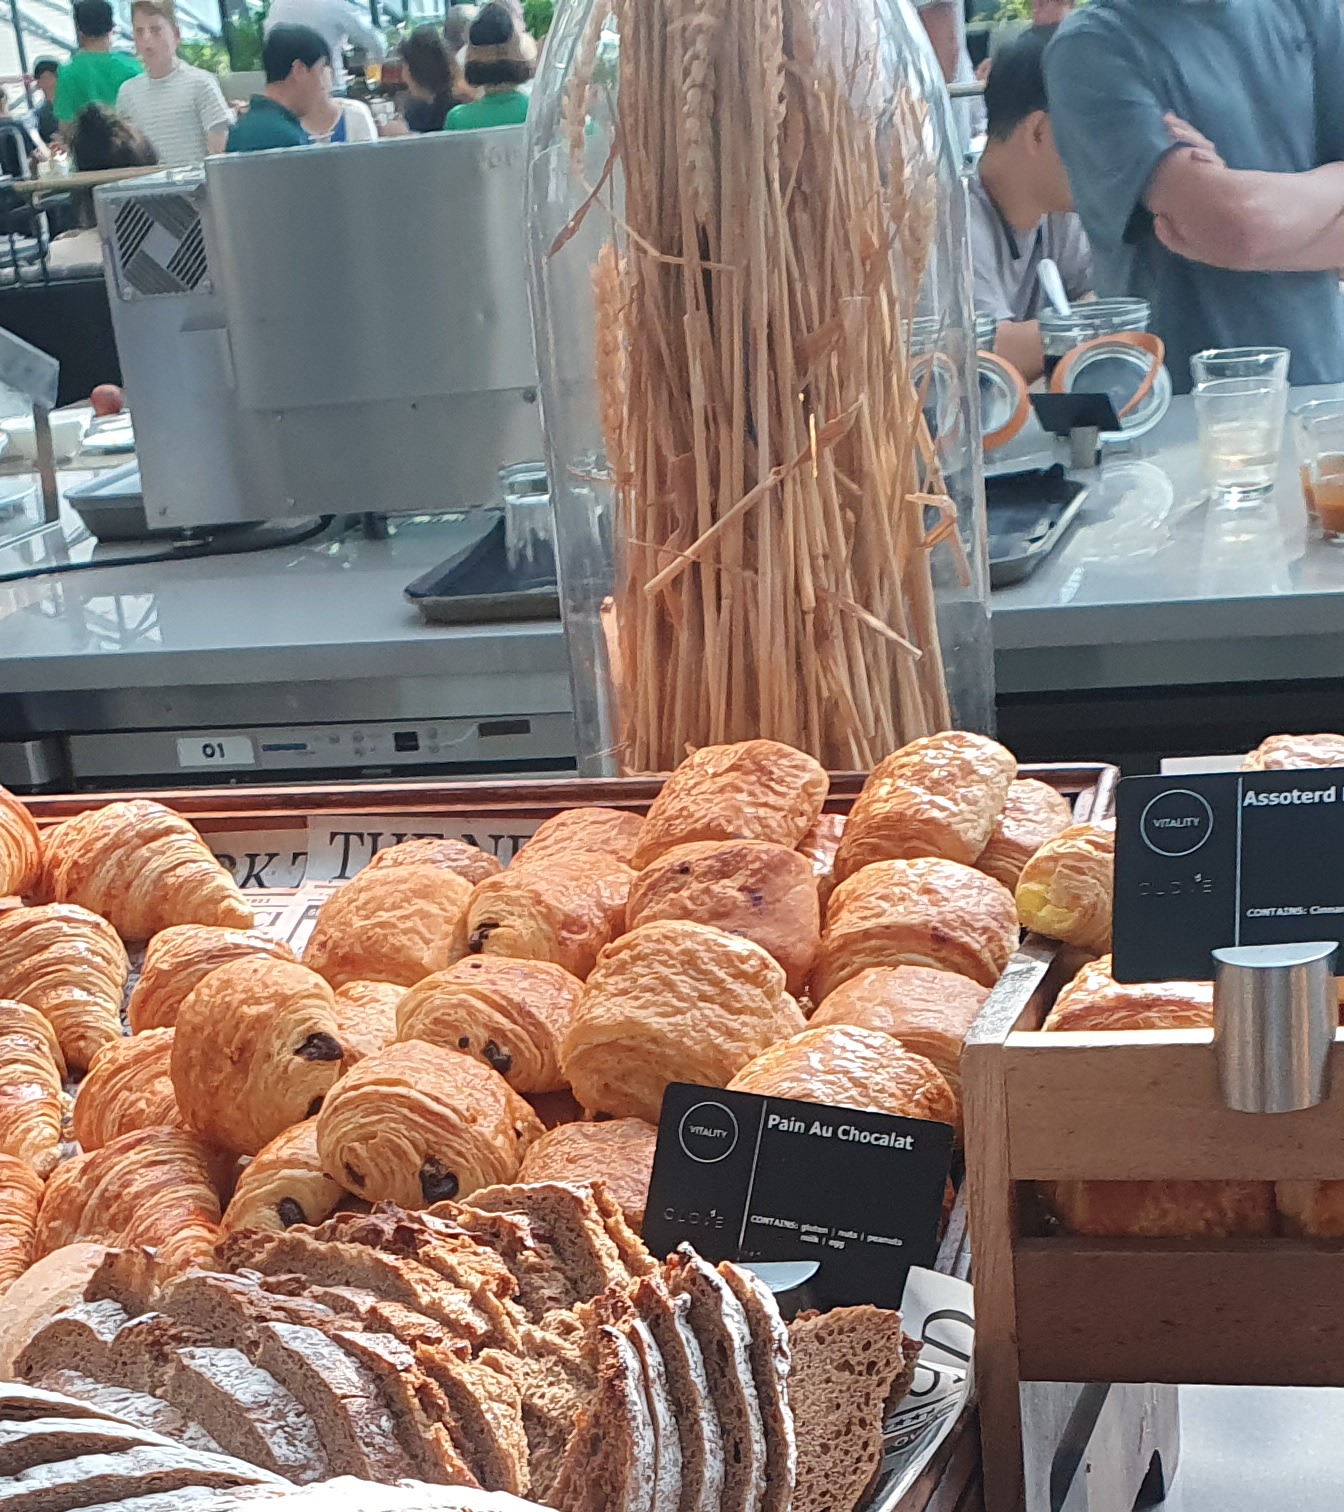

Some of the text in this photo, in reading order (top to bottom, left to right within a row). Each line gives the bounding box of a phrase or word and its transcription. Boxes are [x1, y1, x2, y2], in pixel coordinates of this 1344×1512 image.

[202, 742, 225, 758] 01
[1243, 785, 1337, 807] Assoterd
[1153, 816, 1200, 829] VITALITY
[689, 1123, 728, 1139] VITALITY
[767, 1113, 915, 1151] Pain Au Chocalat
